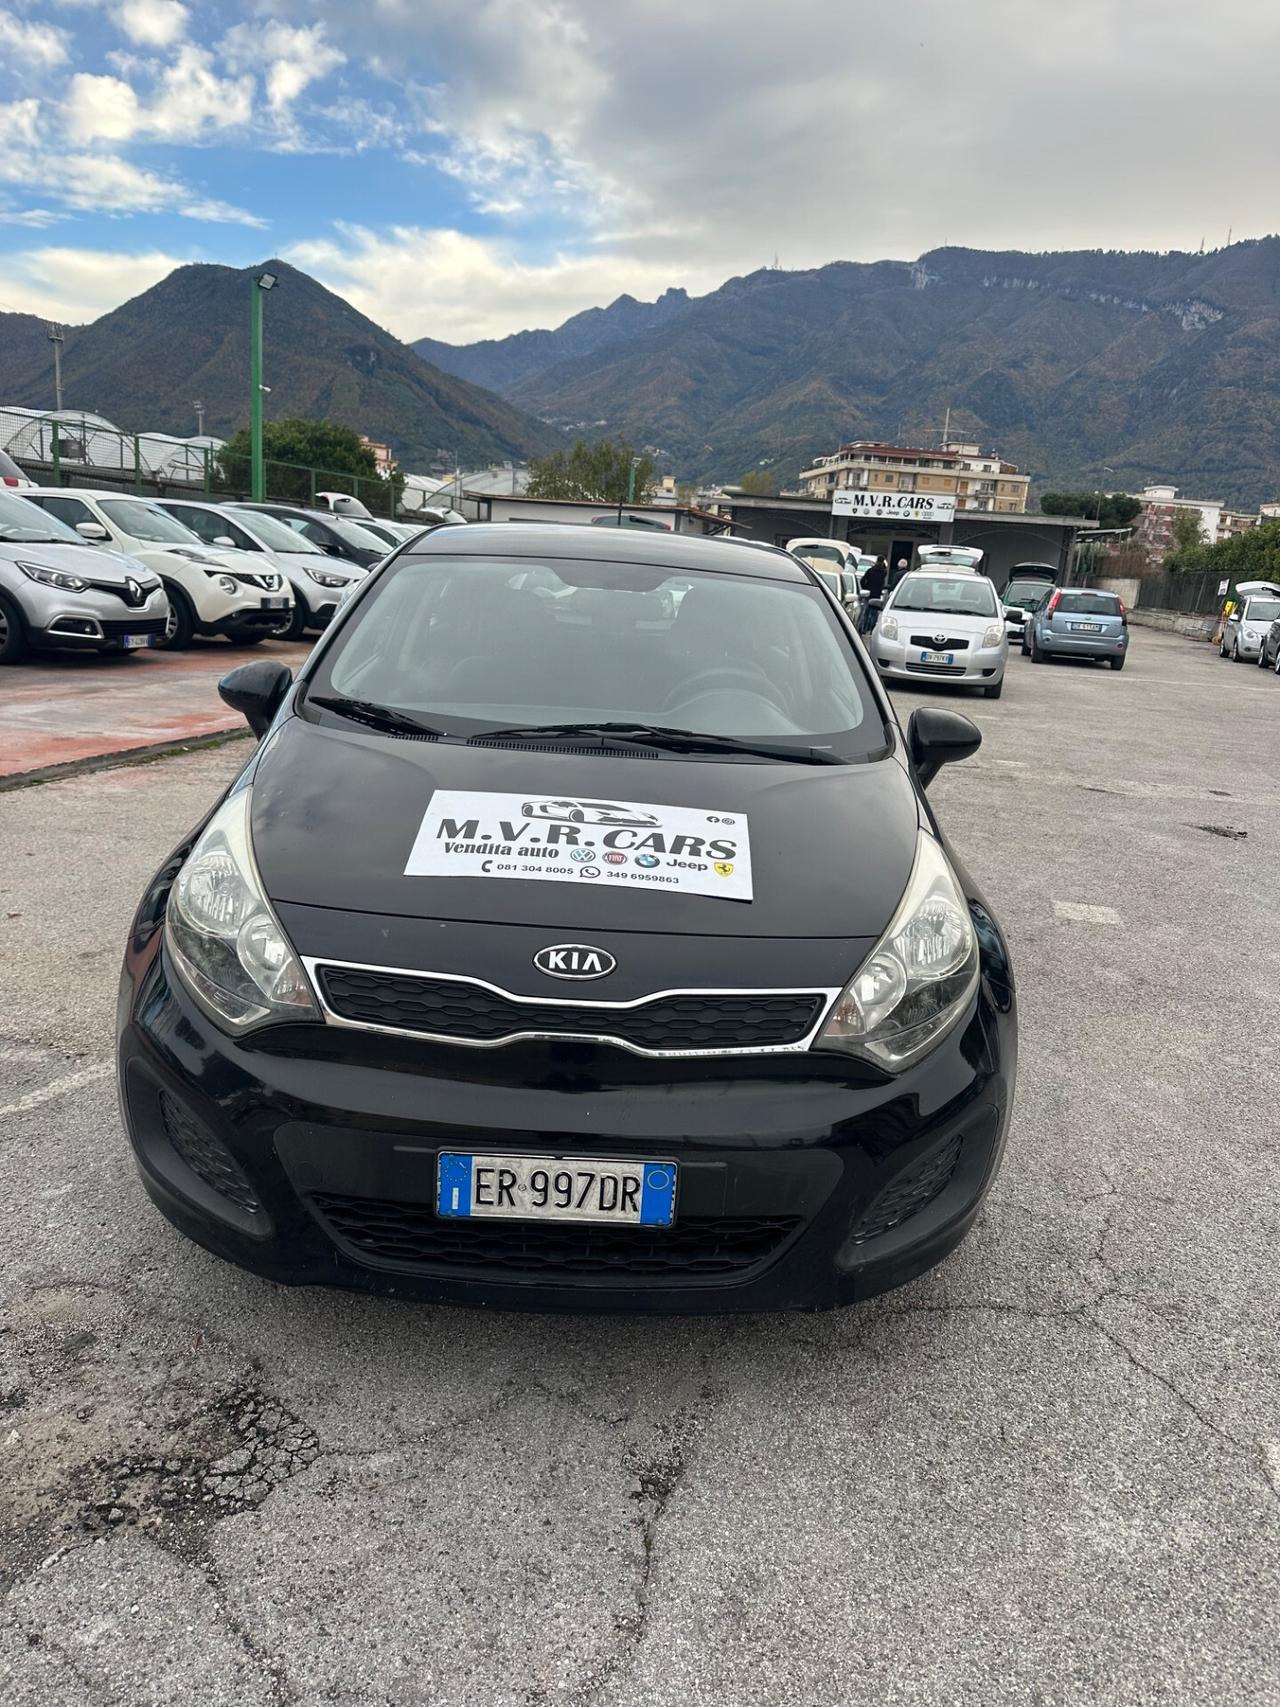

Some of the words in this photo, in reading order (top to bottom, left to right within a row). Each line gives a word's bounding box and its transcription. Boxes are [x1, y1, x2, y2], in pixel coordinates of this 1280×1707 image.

[444, 842, 512, 856] Vendita
[517, 846, 560, 858] auto
[496, 863, 518, 871] 081
[521, 864, 542, 872] 304
[545, 865, 574, 875] 8005
[666, 859, 708, 872] Jeep
[606, 871, 628, 879] 349
[630, 873, 680, 884] 6959863
[548, 951, 602, 972] KIA
